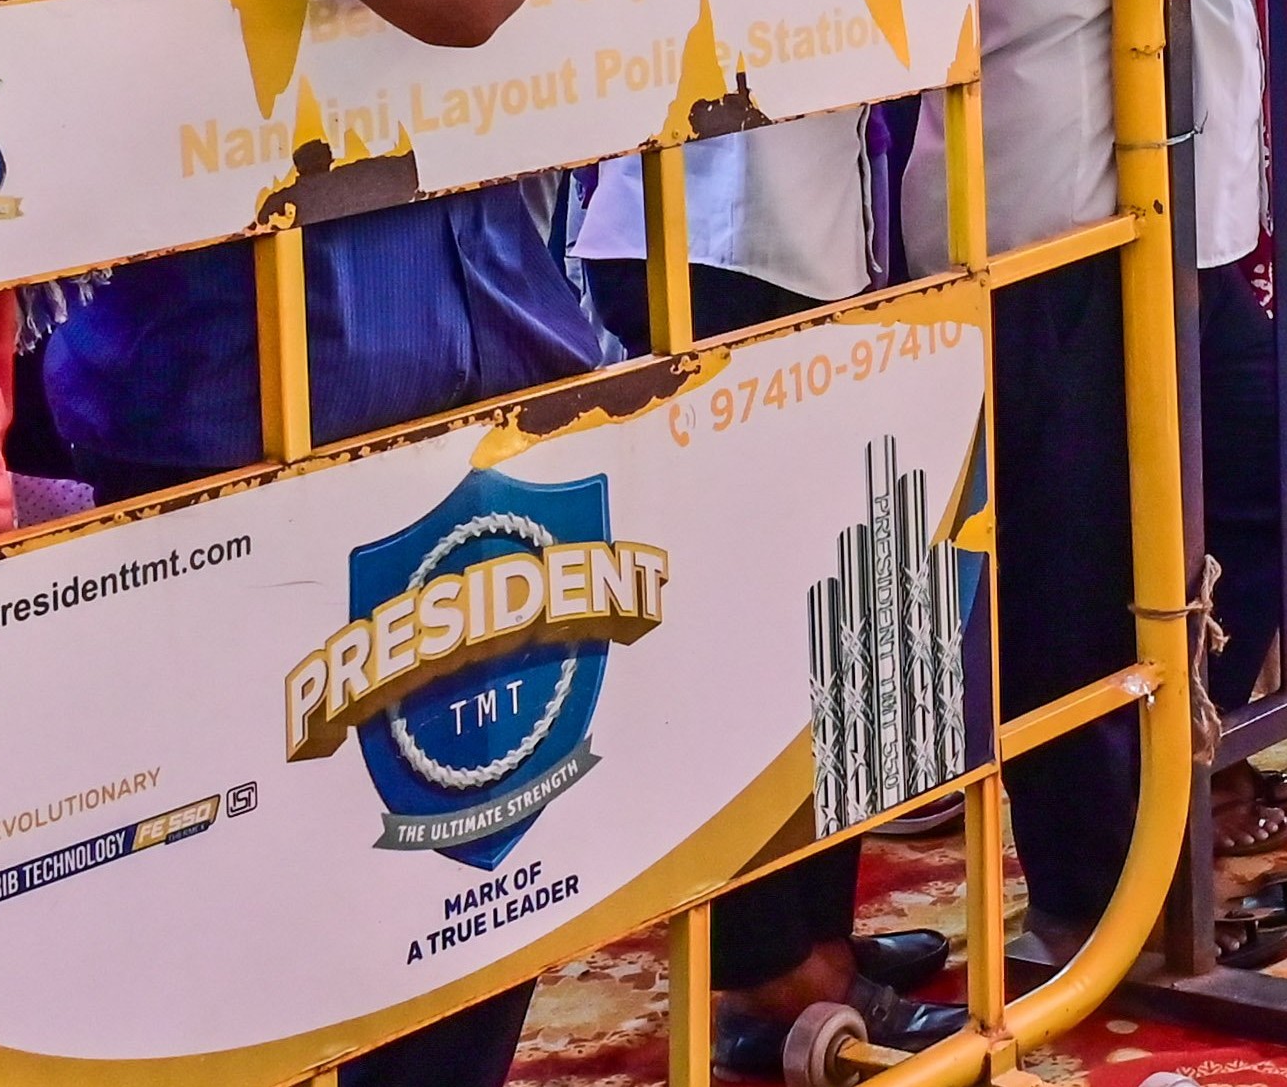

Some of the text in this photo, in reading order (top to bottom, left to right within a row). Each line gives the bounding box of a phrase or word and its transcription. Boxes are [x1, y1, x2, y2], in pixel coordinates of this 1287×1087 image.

[179, 88, 390, 178] Nanini
[410, 58, 579, 136] Layout
[594, 40, 732, 100] Polie
[710, 320, 962, 432] 97410-97410
[874, 494, 898, 662] PRESIDENT
[287, 542, 668, 752] PRESIDENT
[449, 680, 523, 735] TMT
[398, 759, 579, 843] THE ULTIMATE STRENGTH
[22, 831, 127, 891] TECHNOLOGY
[444, 861, 542, 920] MARK OF
[407, 875, 580, 965] A TRUE LEADER
